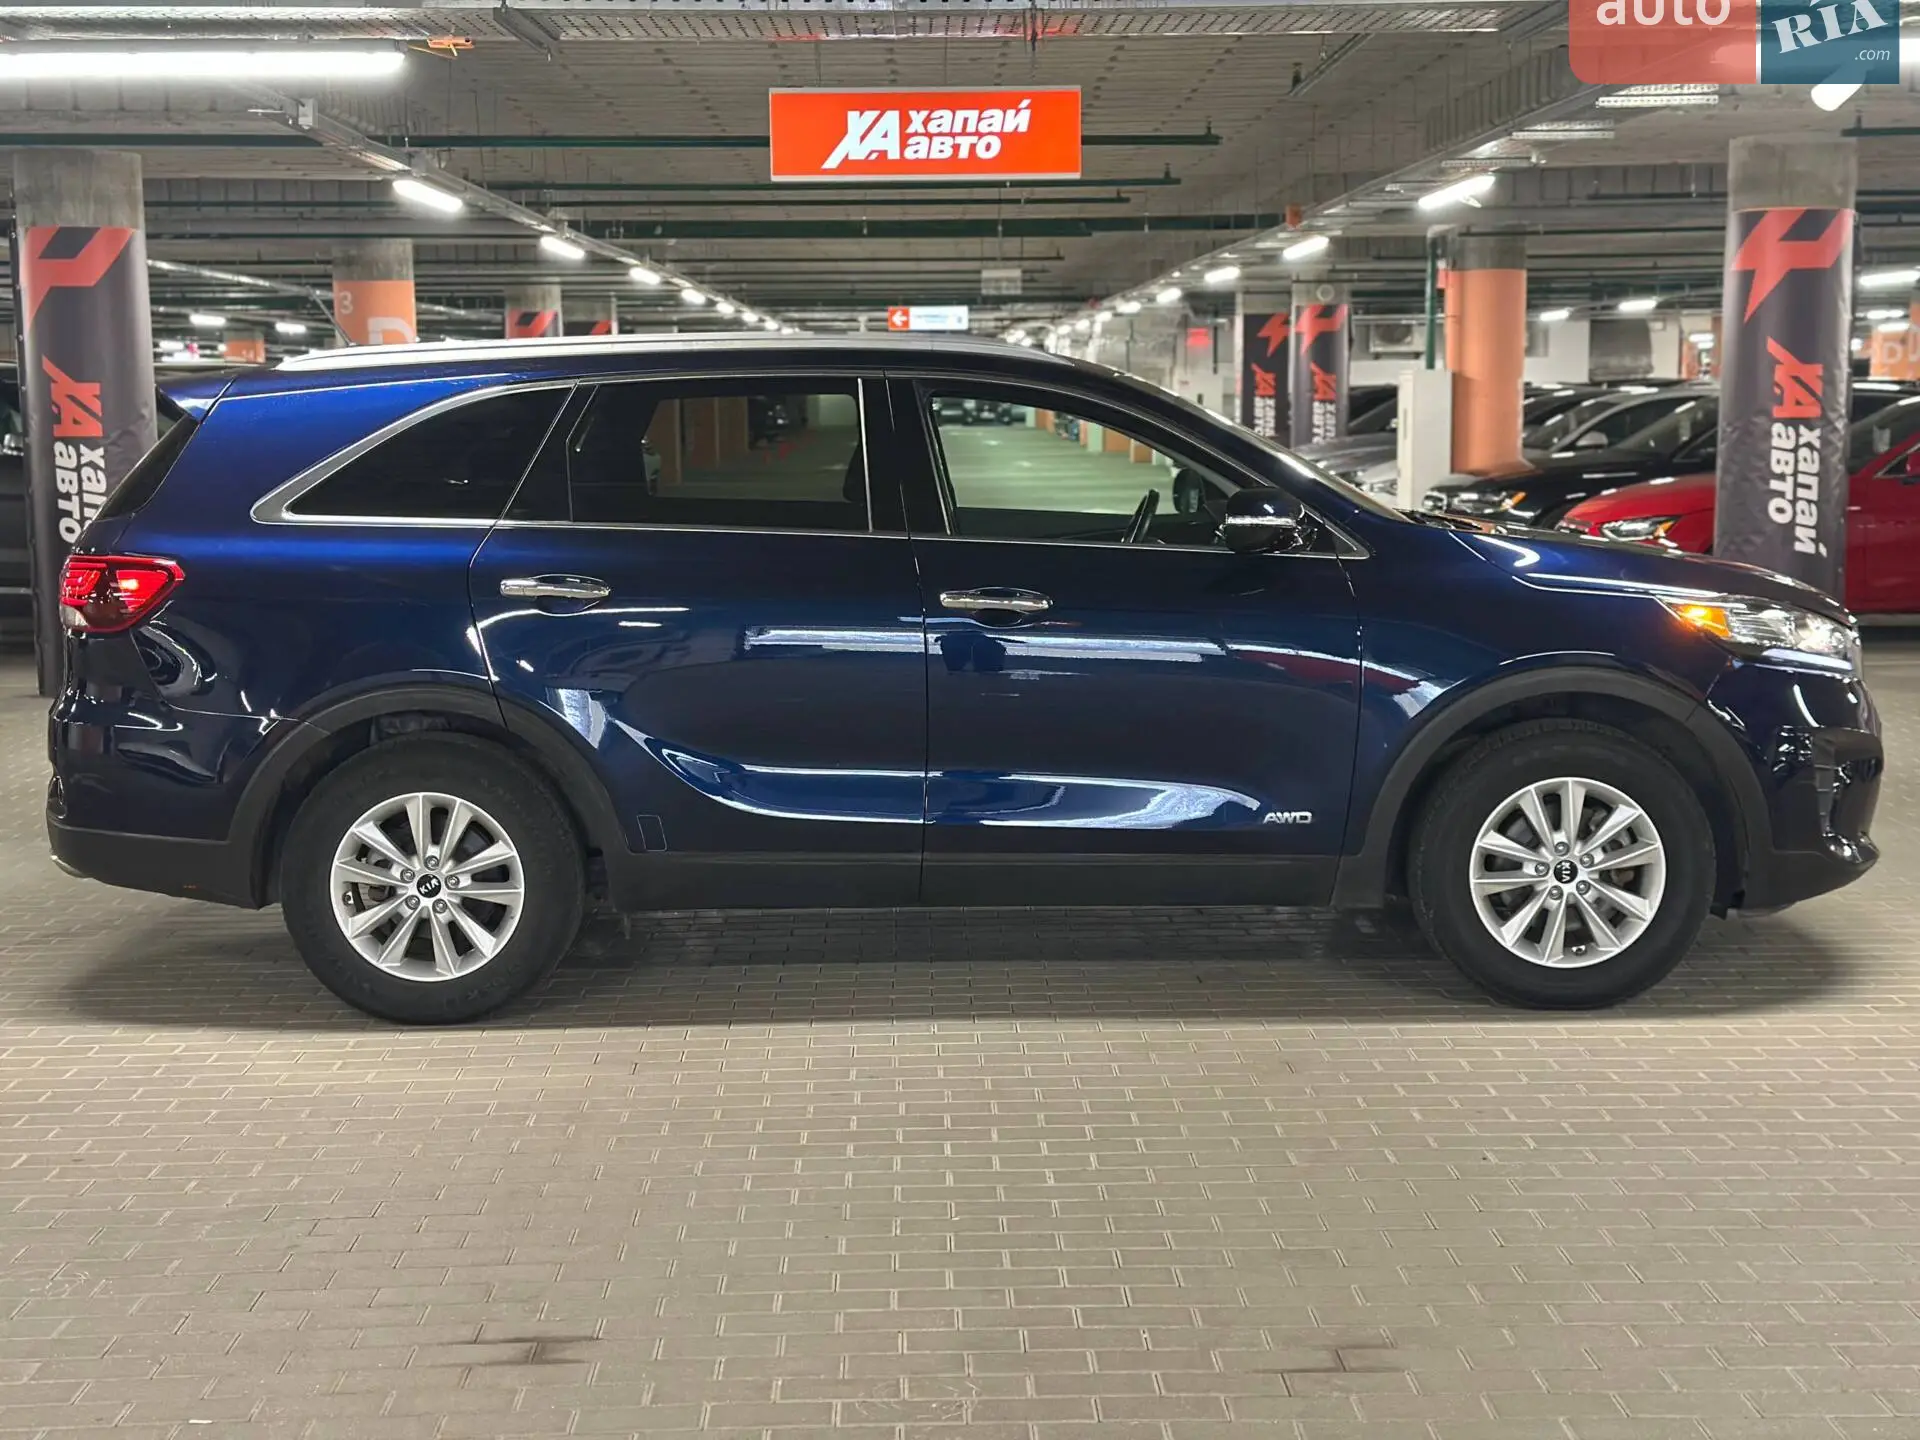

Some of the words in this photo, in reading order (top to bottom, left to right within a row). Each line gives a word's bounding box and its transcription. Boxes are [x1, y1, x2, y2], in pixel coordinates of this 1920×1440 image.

[904, 99, 1032, 133] хапай
[903, 135, 1001, 159] авто
[1768, 422, 1796, 524] авто
[53, 441, 82, 543] авто
[1794, 423, 1827, 558] хапай
[1262, 811, 1312, 824] AWD
[419, 878, 439, 895] KIA
[1561, 862, 1571, 882] KIA
